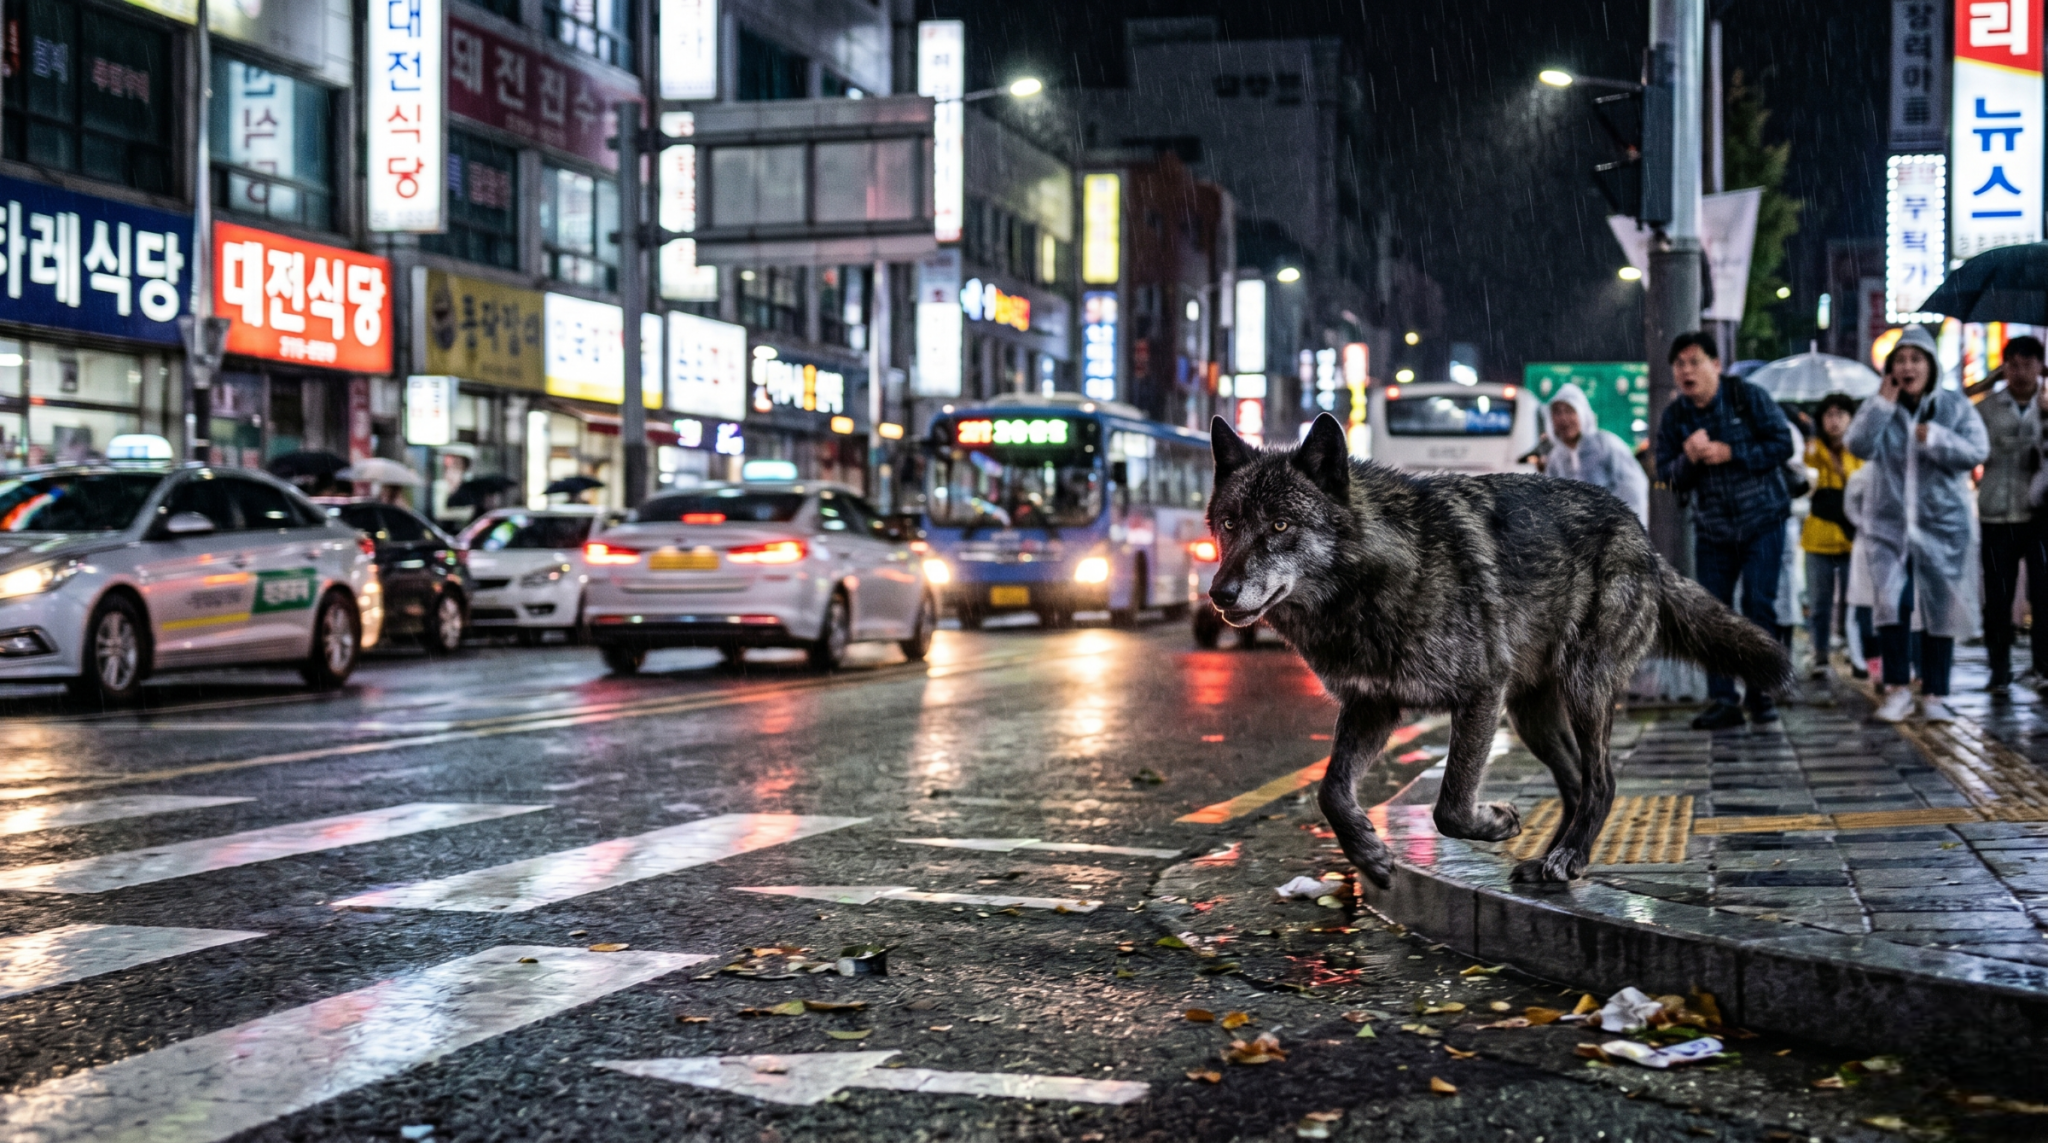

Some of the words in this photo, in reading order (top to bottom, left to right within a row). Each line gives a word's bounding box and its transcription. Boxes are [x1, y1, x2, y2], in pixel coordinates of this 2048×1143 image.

[387, 0, 425, 198] 대전식당
[1970, 97, 2024, 219] 뉴스
[222, 240, 387, 347] 대전식당
